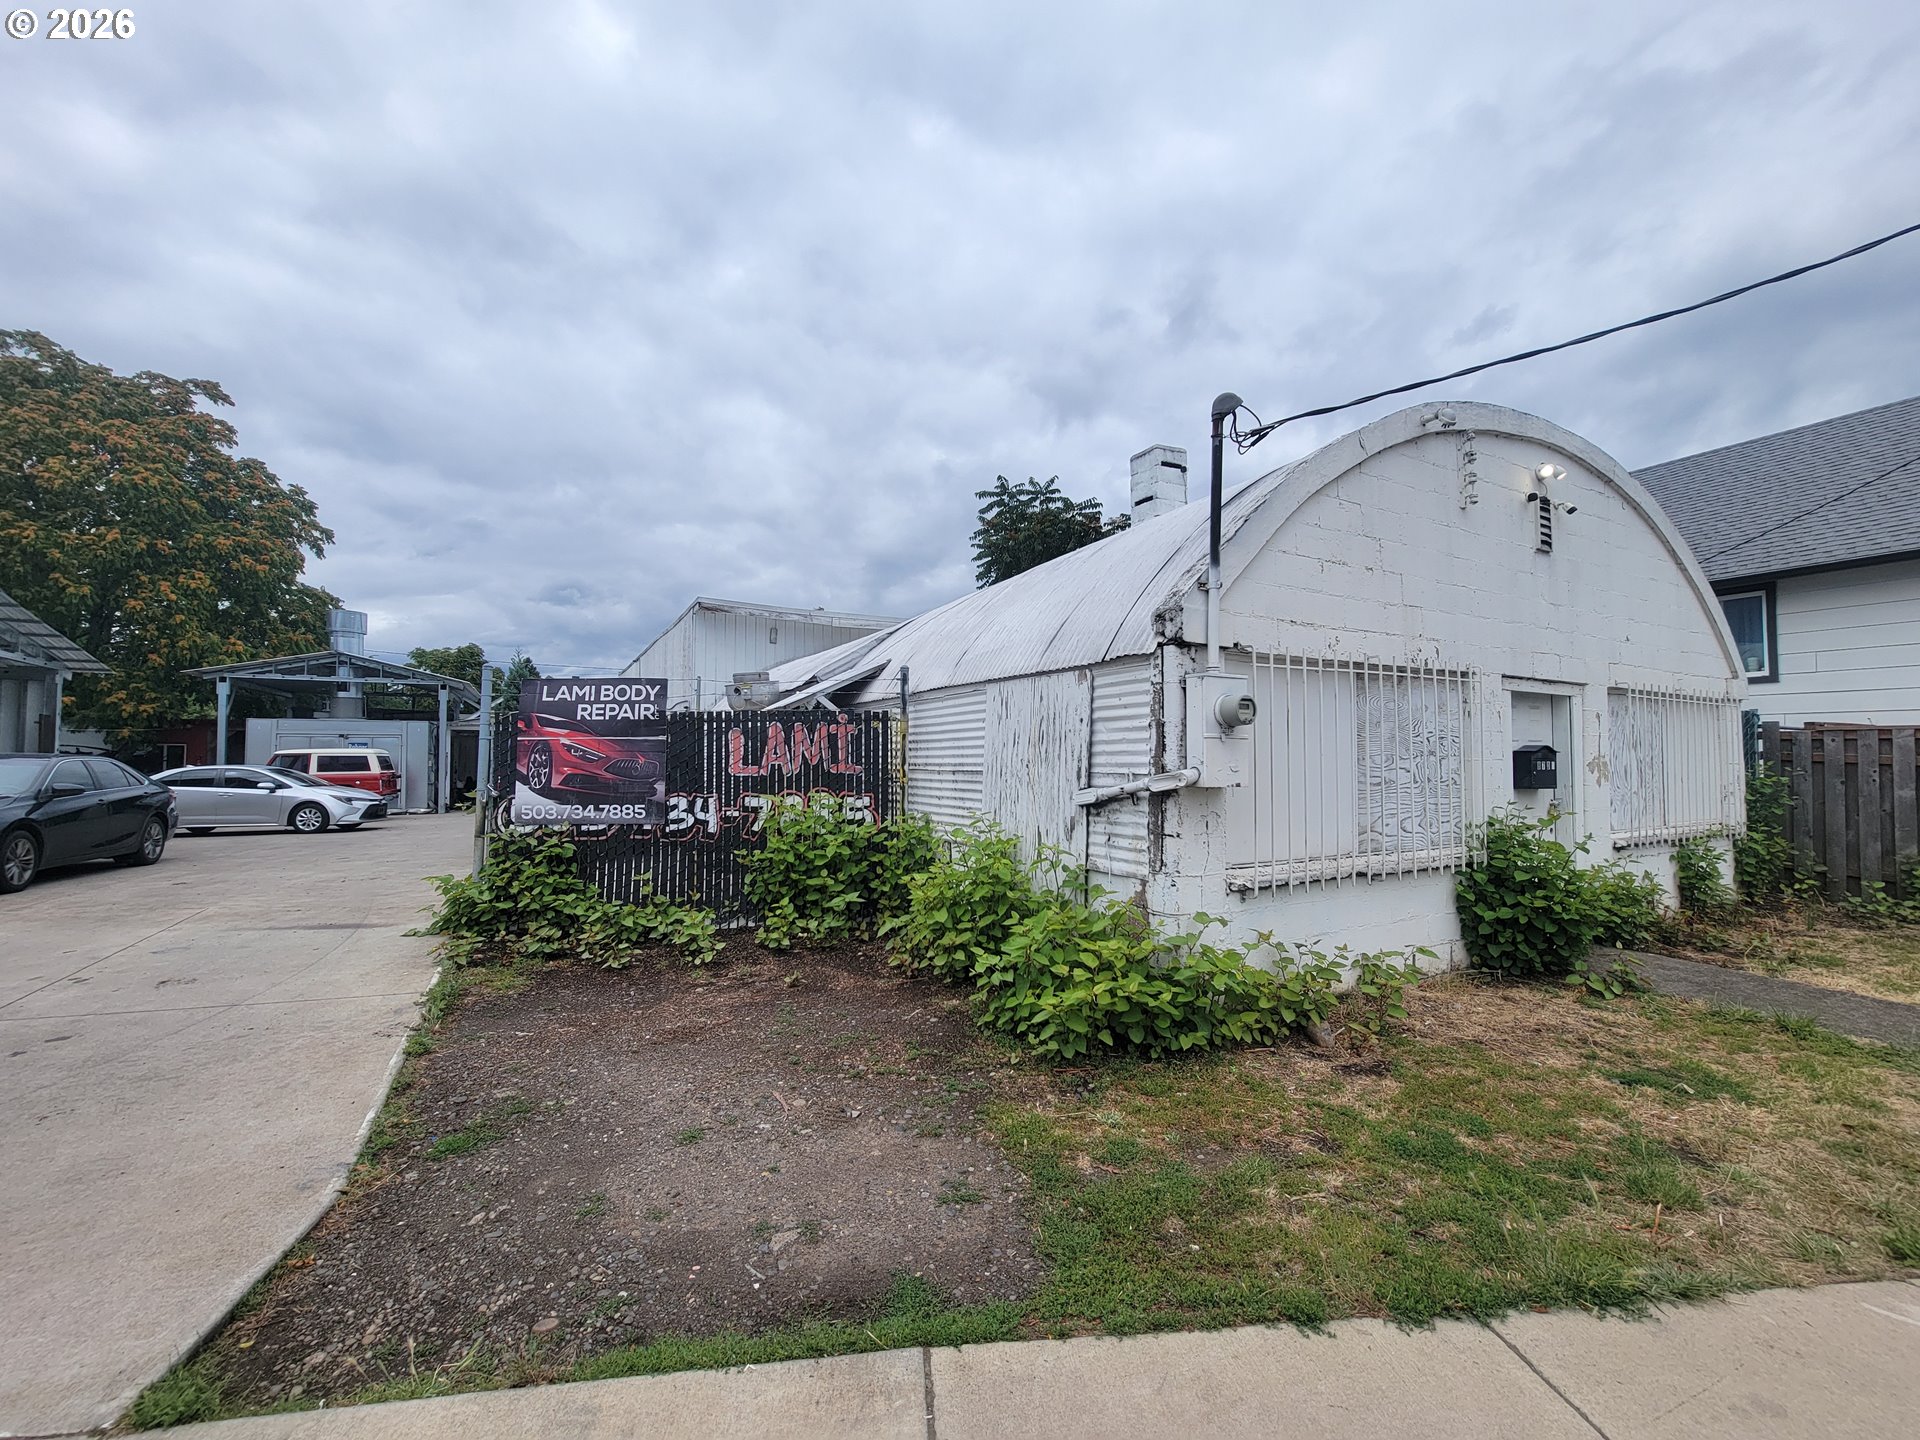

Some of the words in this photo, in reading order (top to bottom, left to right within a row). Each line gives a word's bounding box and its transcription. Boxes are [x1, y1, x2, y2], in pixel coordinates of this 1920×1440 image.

[542, 685, 596, 701] LAMI
[599, 684, 661, 701] BODY
[577, 703, 656, 720] REPAIR
[728, 713, 864, 777] LAMI
[521, 804, 646, 820] 503.734.7885
